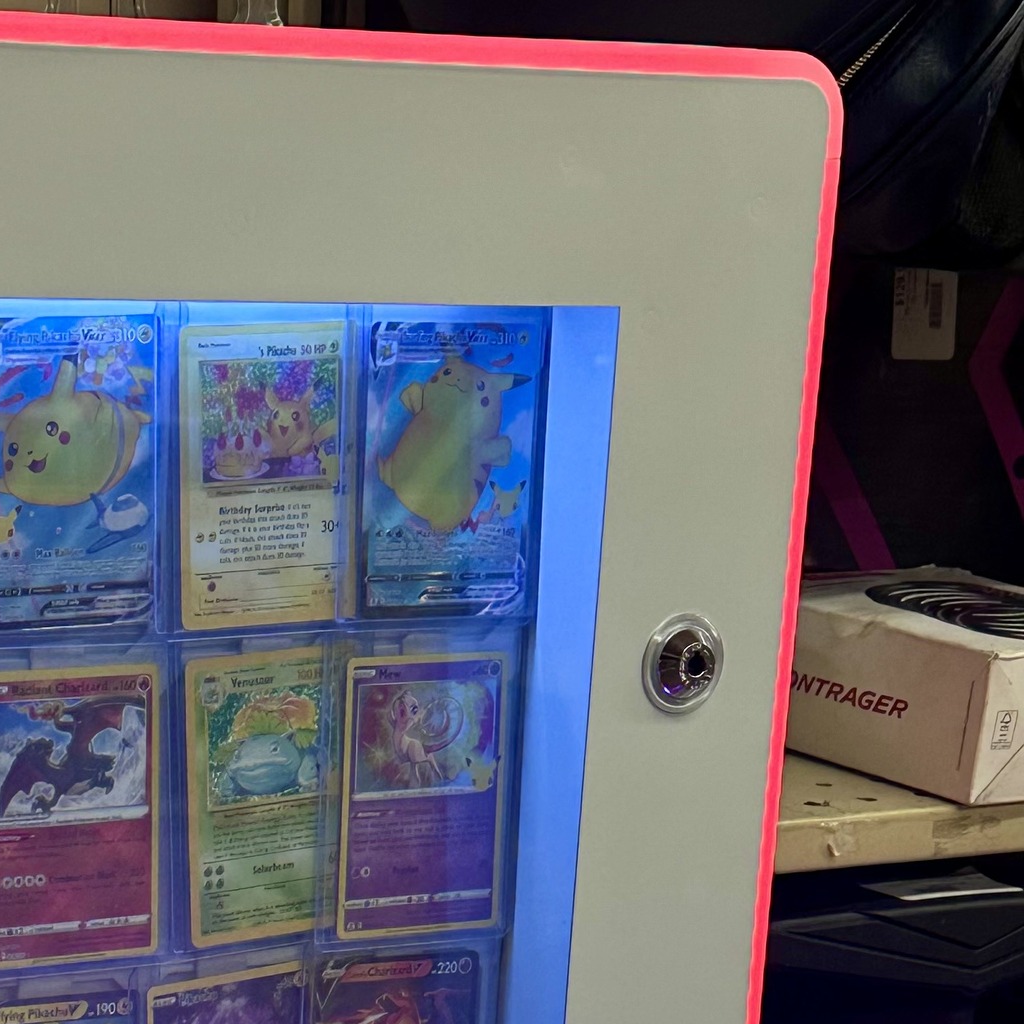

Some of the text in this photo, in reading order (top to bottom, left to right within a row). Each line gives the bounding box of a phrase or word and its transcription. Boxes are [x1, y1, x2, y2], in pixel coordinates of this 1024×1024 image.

[437, 960, 458, 975] 220
[28, 1005, 68, 1020] Pikachu
[96, 1001, 117, 1016] 190
